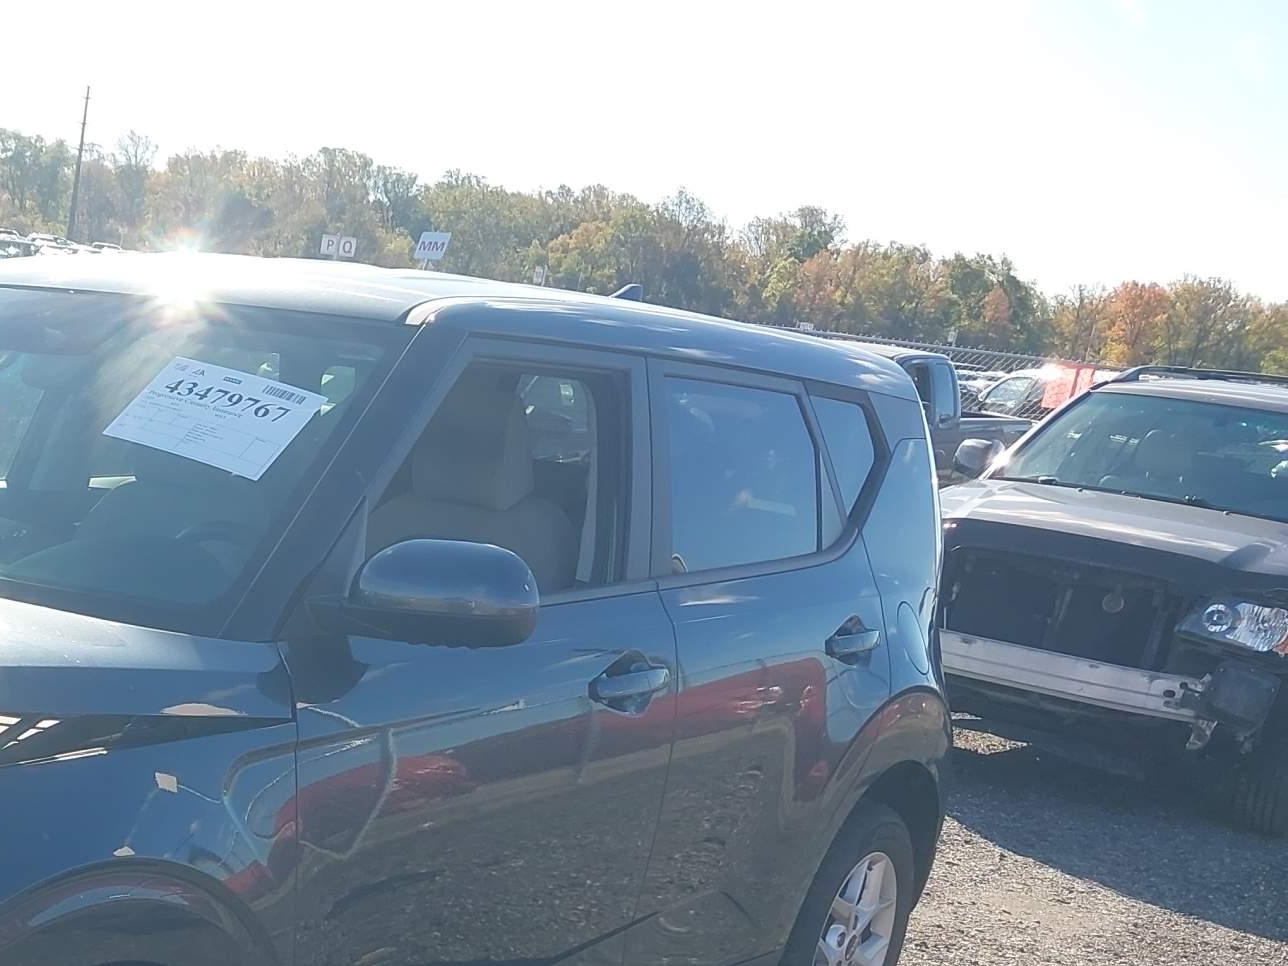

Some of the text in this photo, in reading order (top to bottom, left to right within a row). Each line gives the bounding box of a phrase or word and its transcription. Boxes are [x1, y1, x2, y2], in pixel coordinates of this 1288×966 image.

[326, 239, 353, 254] P Q
[418, 239, 446, 252] MM
[164, 378, 292, 423] 43479767
